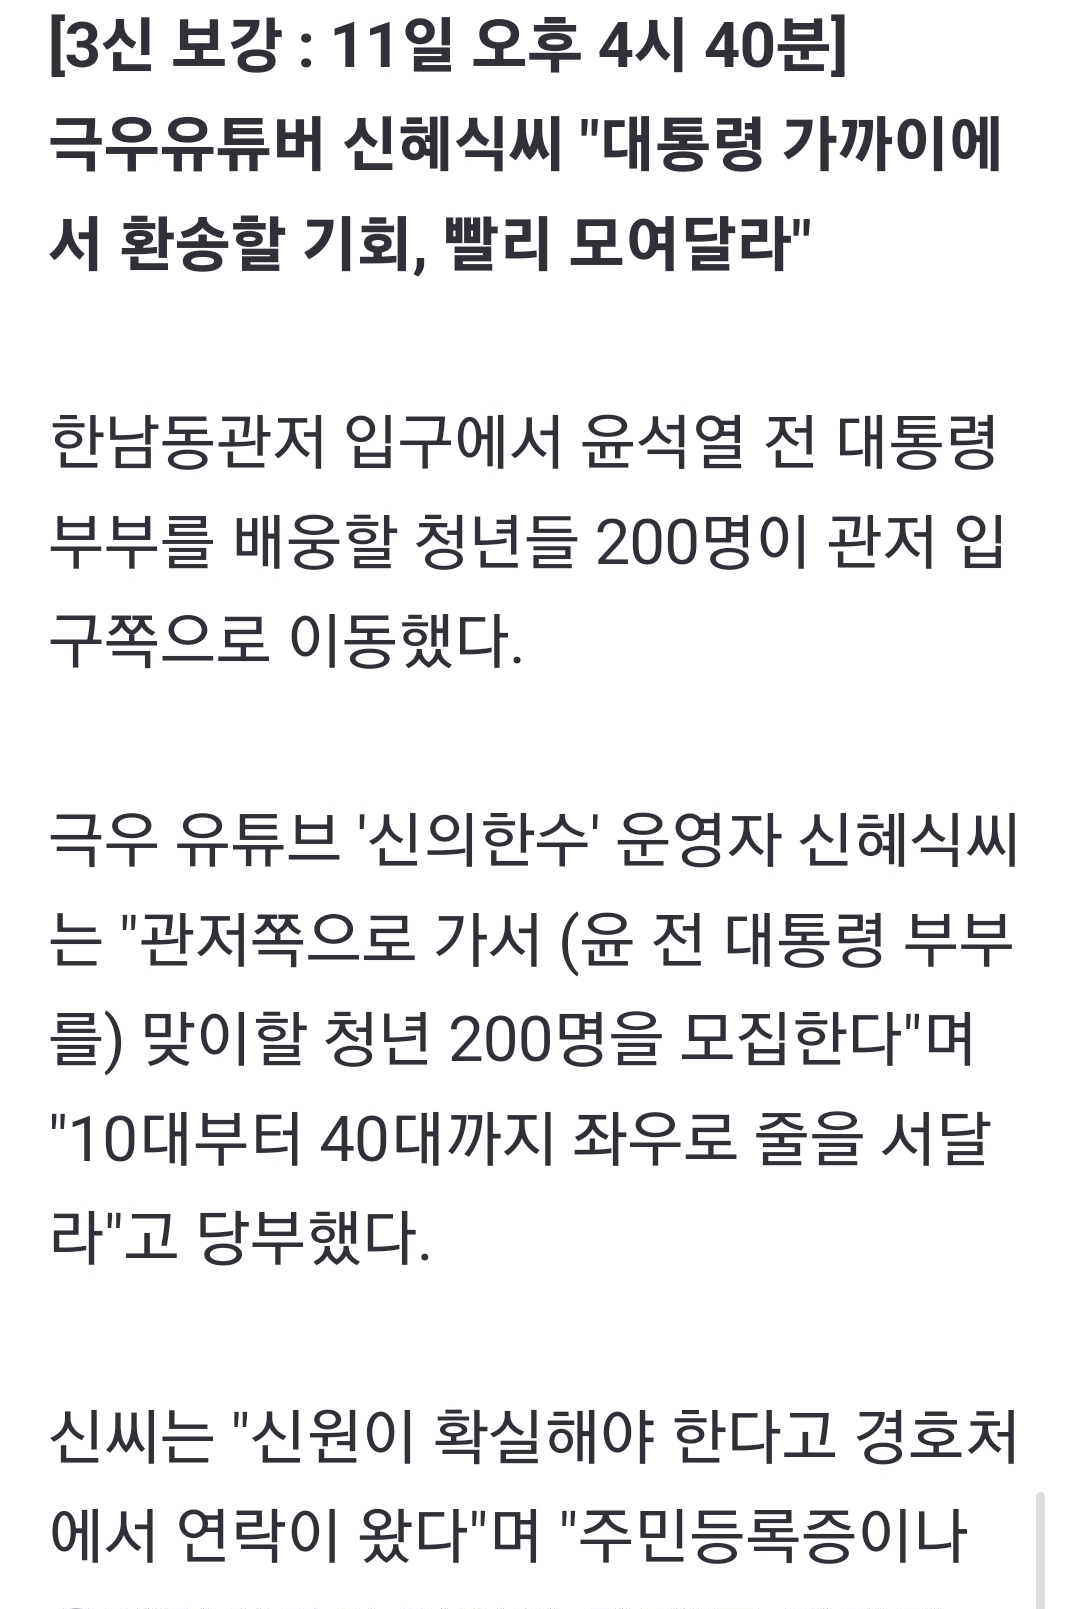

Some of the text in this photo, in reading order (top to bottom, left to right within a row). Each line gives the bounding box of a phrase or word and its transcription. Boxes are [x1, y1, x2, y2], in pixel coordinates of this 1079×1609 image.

[50, 12, 153, 79] [3신
[171, 16, 284, 75] 보강
[333, 15, 453, 74] 11일
[472, 15, 583, 75] 오후
[597, 15, 684, 74] 4시
[704, 12, 847, 79] 40분]
[48, 114, 1001, 174] 극우유튜버 신혜식씨 "대통령 가까이에
[48, 214, 812, 278] 서 환송할 기회, 빨리 모여달라"
[51, 413, 995, 472] 한남동관저 입구에서 윤석열 전 대통령
[49, 612, 522, 671] 구쪽으로 이동했다.
[49, 811, 1017, 869] 극우 유튜브 '신의한수' 운영자 신혜식씨
[49, 1009, 972, 1077] 를) 맞이할 청년 200명을 모집한다"며
[52, 1209, 430, 1267] 라"고 당부했다.
[49, 1408, 1016, 1466] 신씨는 "신원이 확실해야 한다고 경호처
